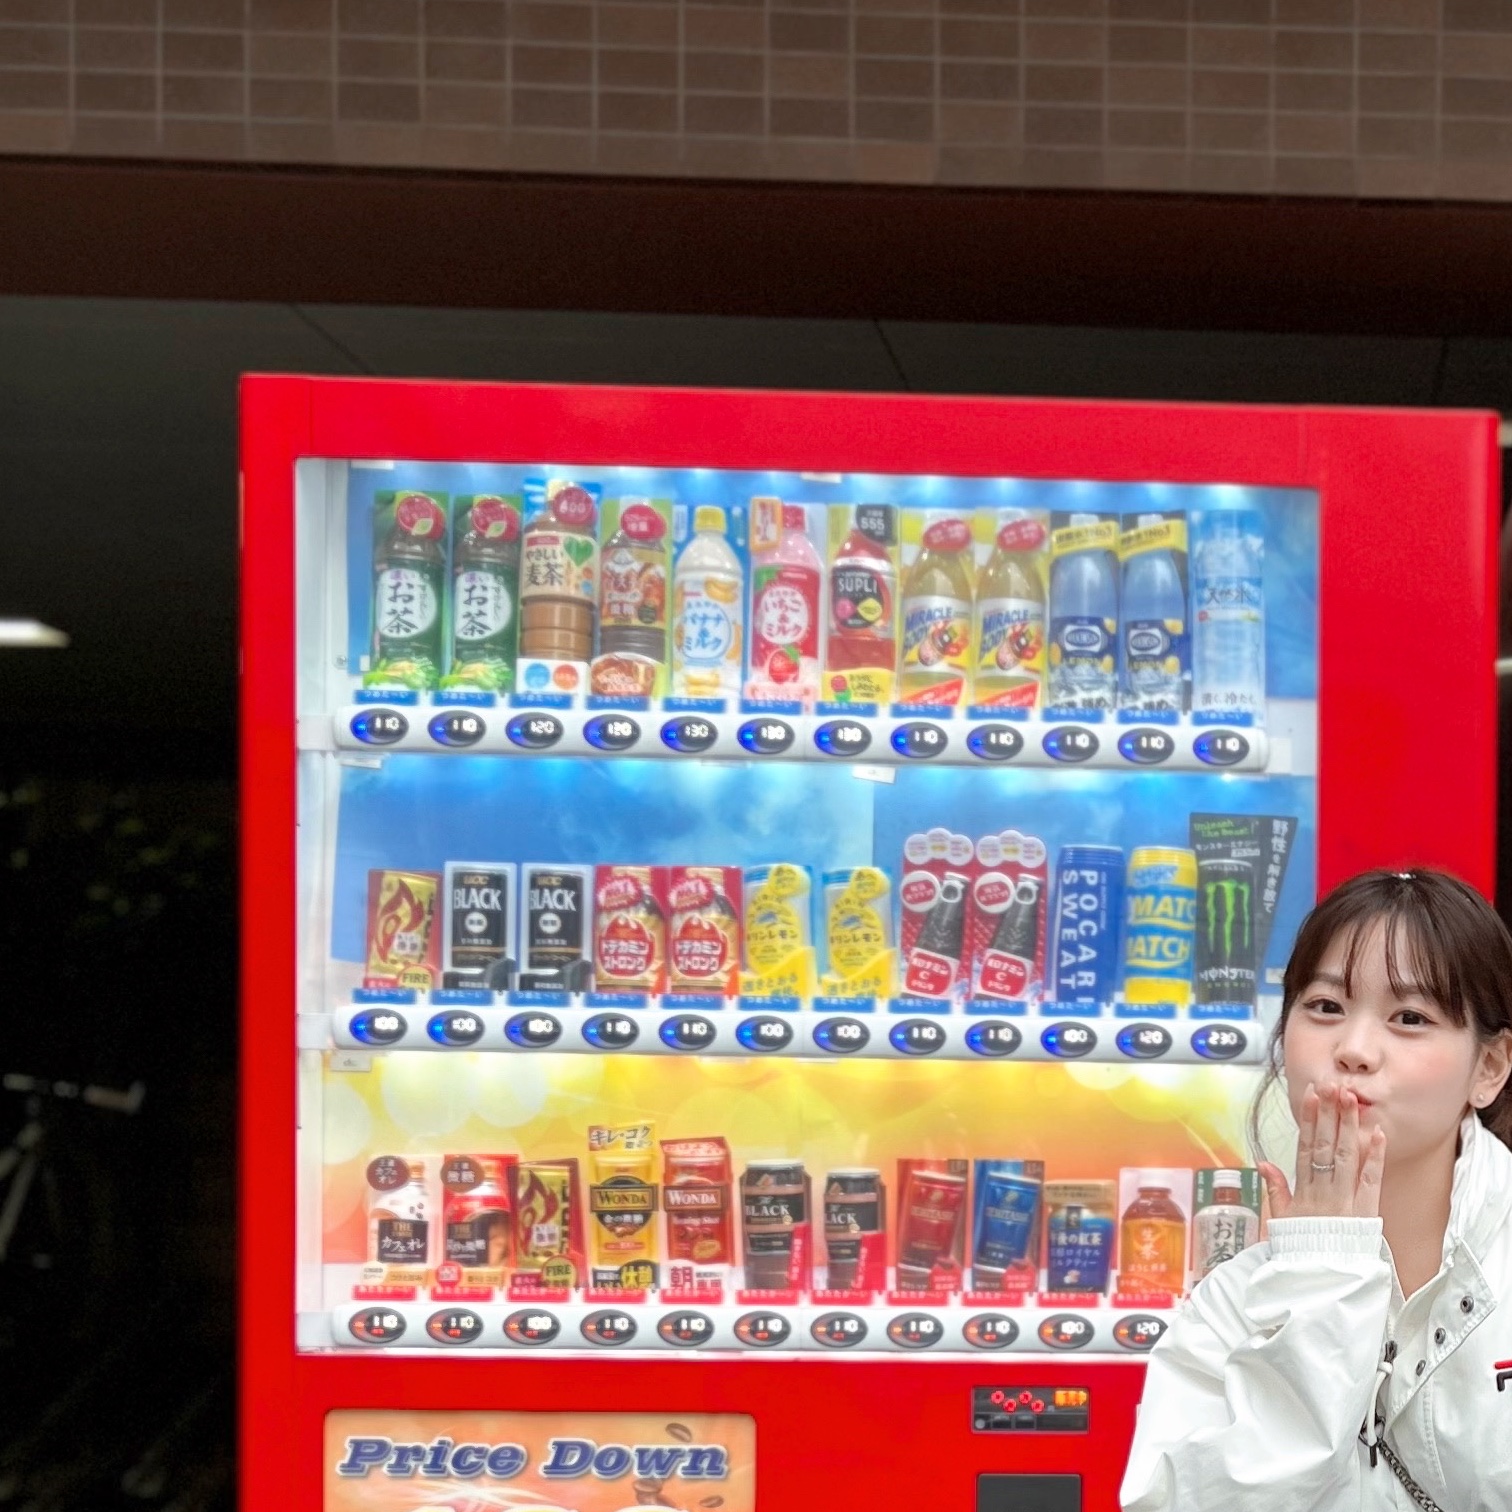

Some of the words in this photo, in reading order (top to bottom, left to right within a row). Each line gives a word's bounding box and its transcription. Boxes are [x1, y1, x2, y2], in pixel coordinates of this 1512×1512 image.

[524, 563, 564, 588] 麦茶
[837, 575, 878, 594] SUPLI
[385, 581, 418, 636] お茶
[462, 583, 494, 637] お茶
[454, 888, 501, 911] BLACK
[529, 889, 577, 912] BLACK
[1060, 872, 1079, 989] SWEAT
[1076, 869, 1099, 1003] POCARI
[402, 974, 429, 984] FIRE
[598, 1191, 647, 1206] WONDA
[668, 1190, 717, 1206] WONDA
[337, 1437, 527, 1479] Price
[541, 1437, 729, 1479] Down
